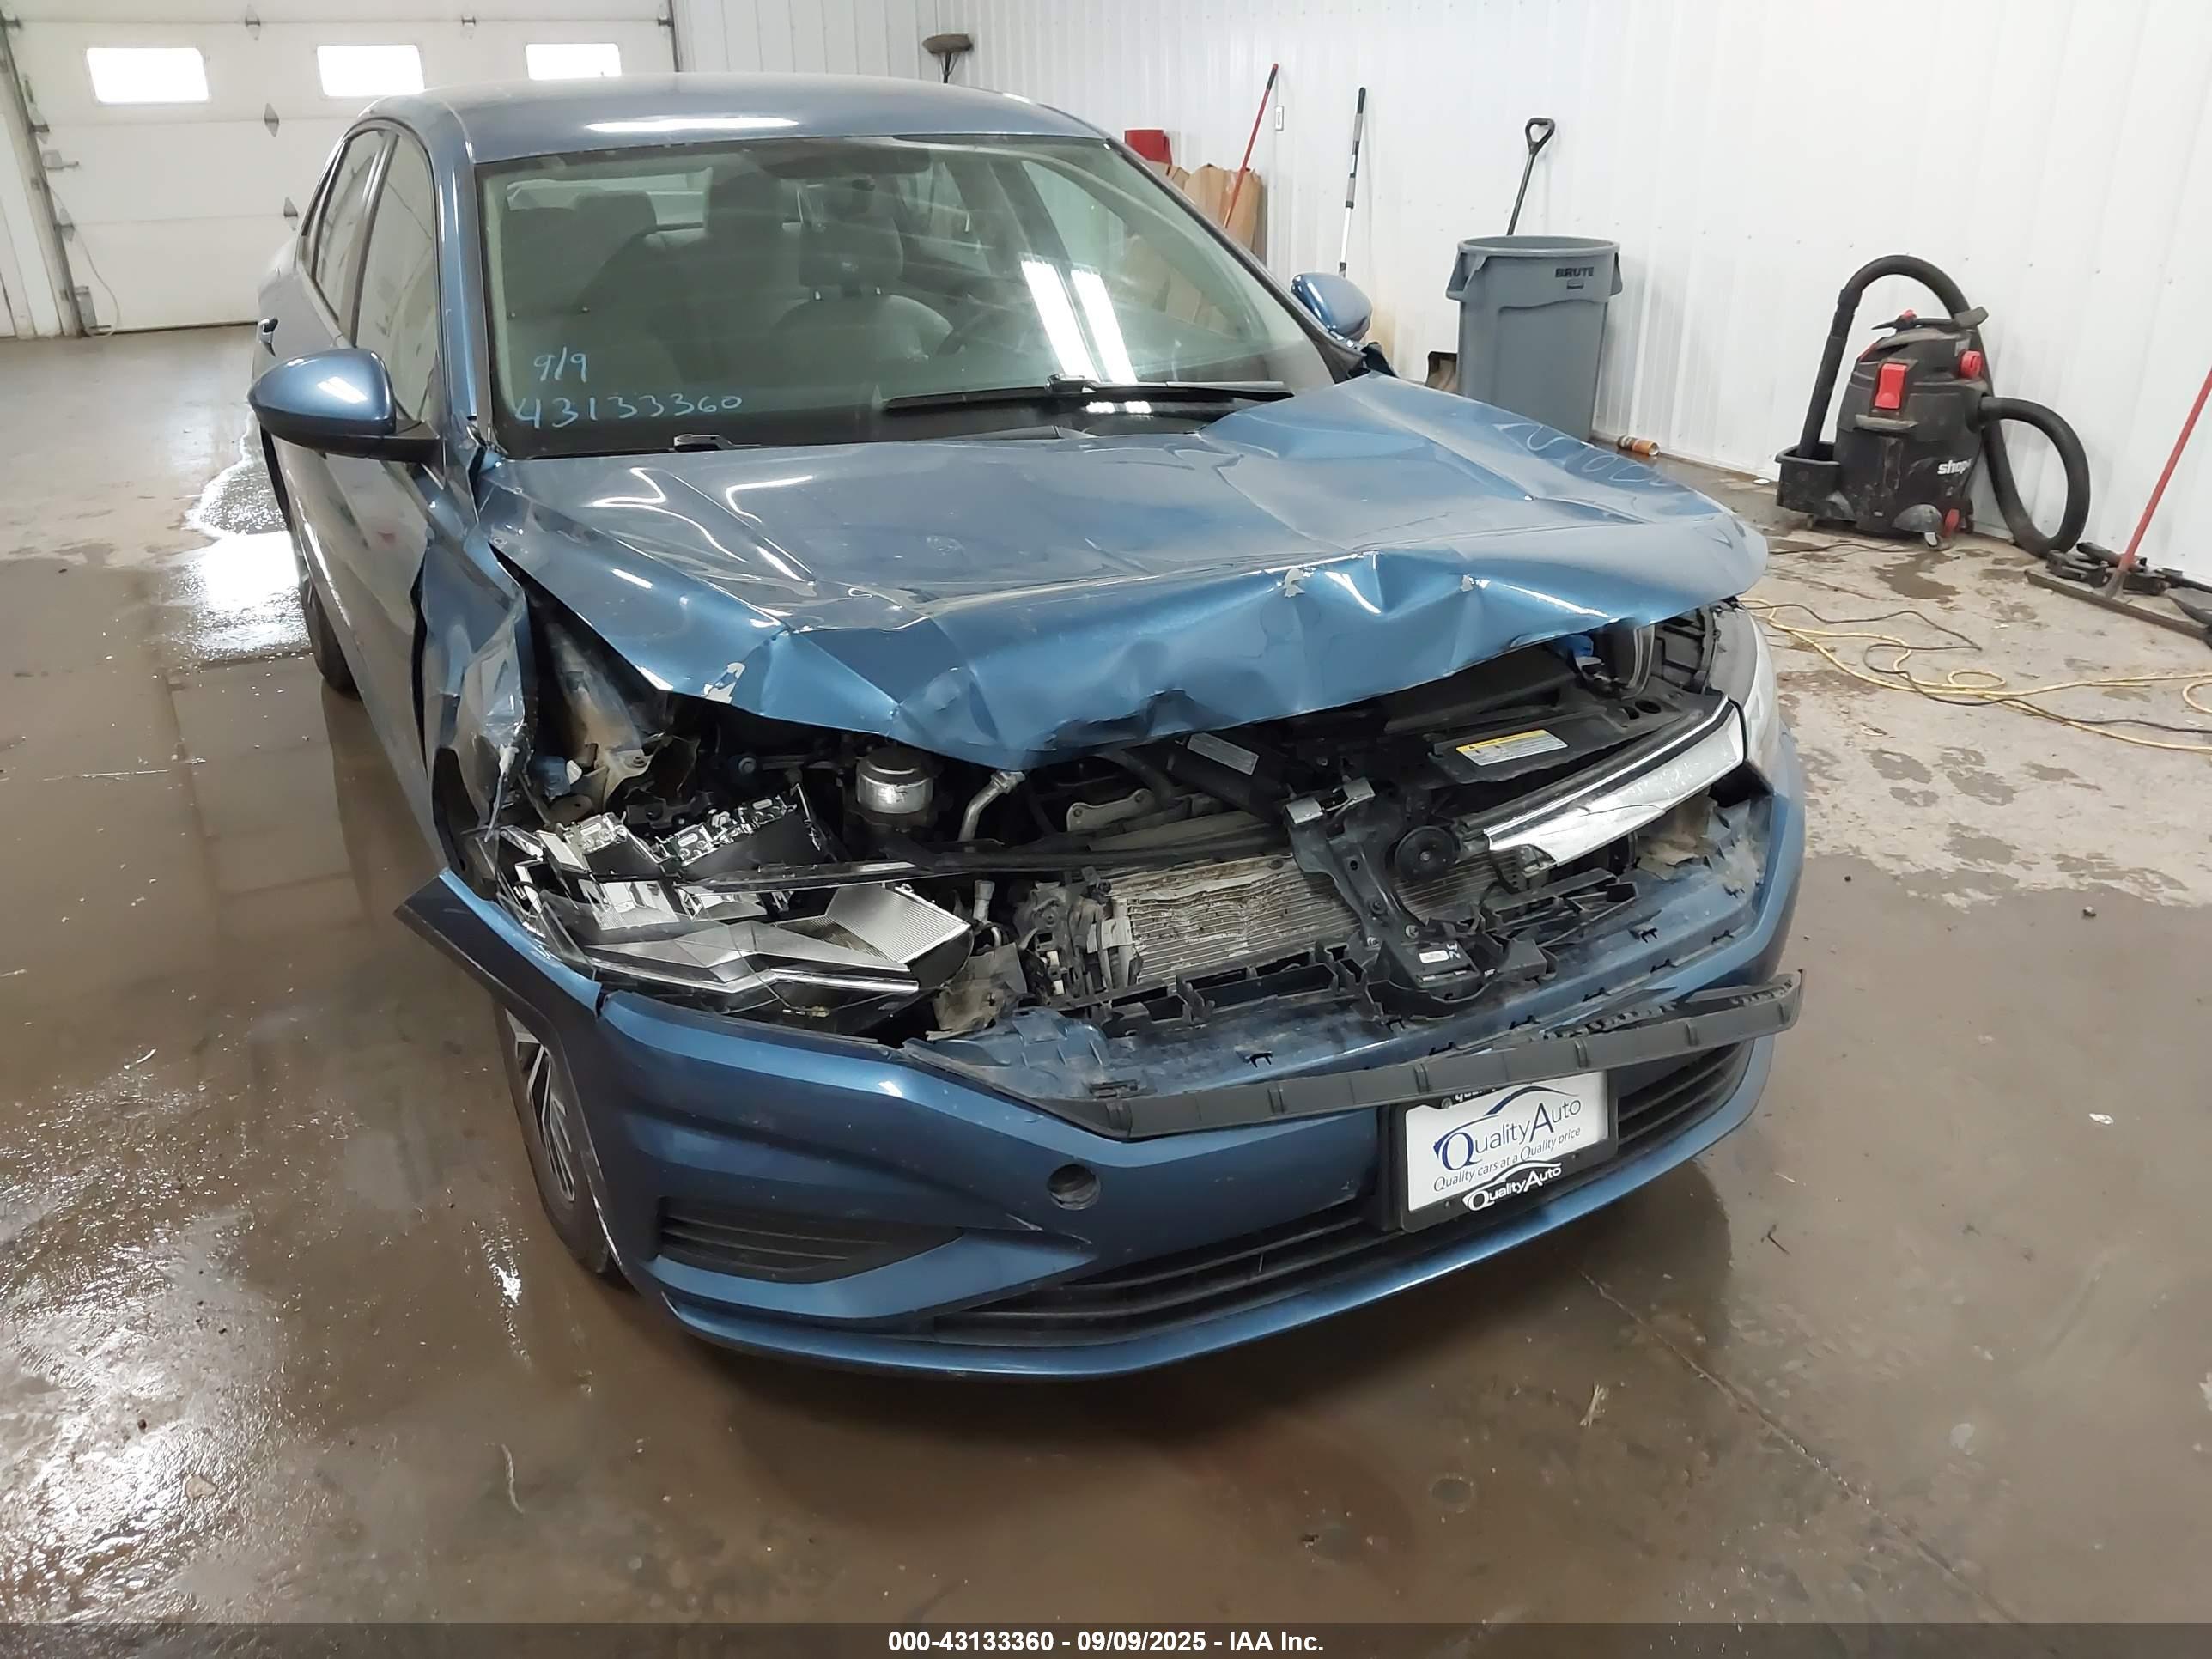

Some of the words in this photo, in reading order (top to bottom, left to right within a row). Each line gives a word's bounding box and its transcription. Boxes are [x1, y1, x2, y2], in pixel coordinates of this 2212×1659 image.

[533, 347, 587, 382] 9/9
[515, 393, 742, 428] 43133360
[1433, 1168, 1475, 1192] Quality
[1478, 1162, 1498, 1176] cars
[1500, 1158, 1510, 1169] at
[1520, 1138, 1556, 1161] Quality
[1559, 1127, 1581, 1145] price
